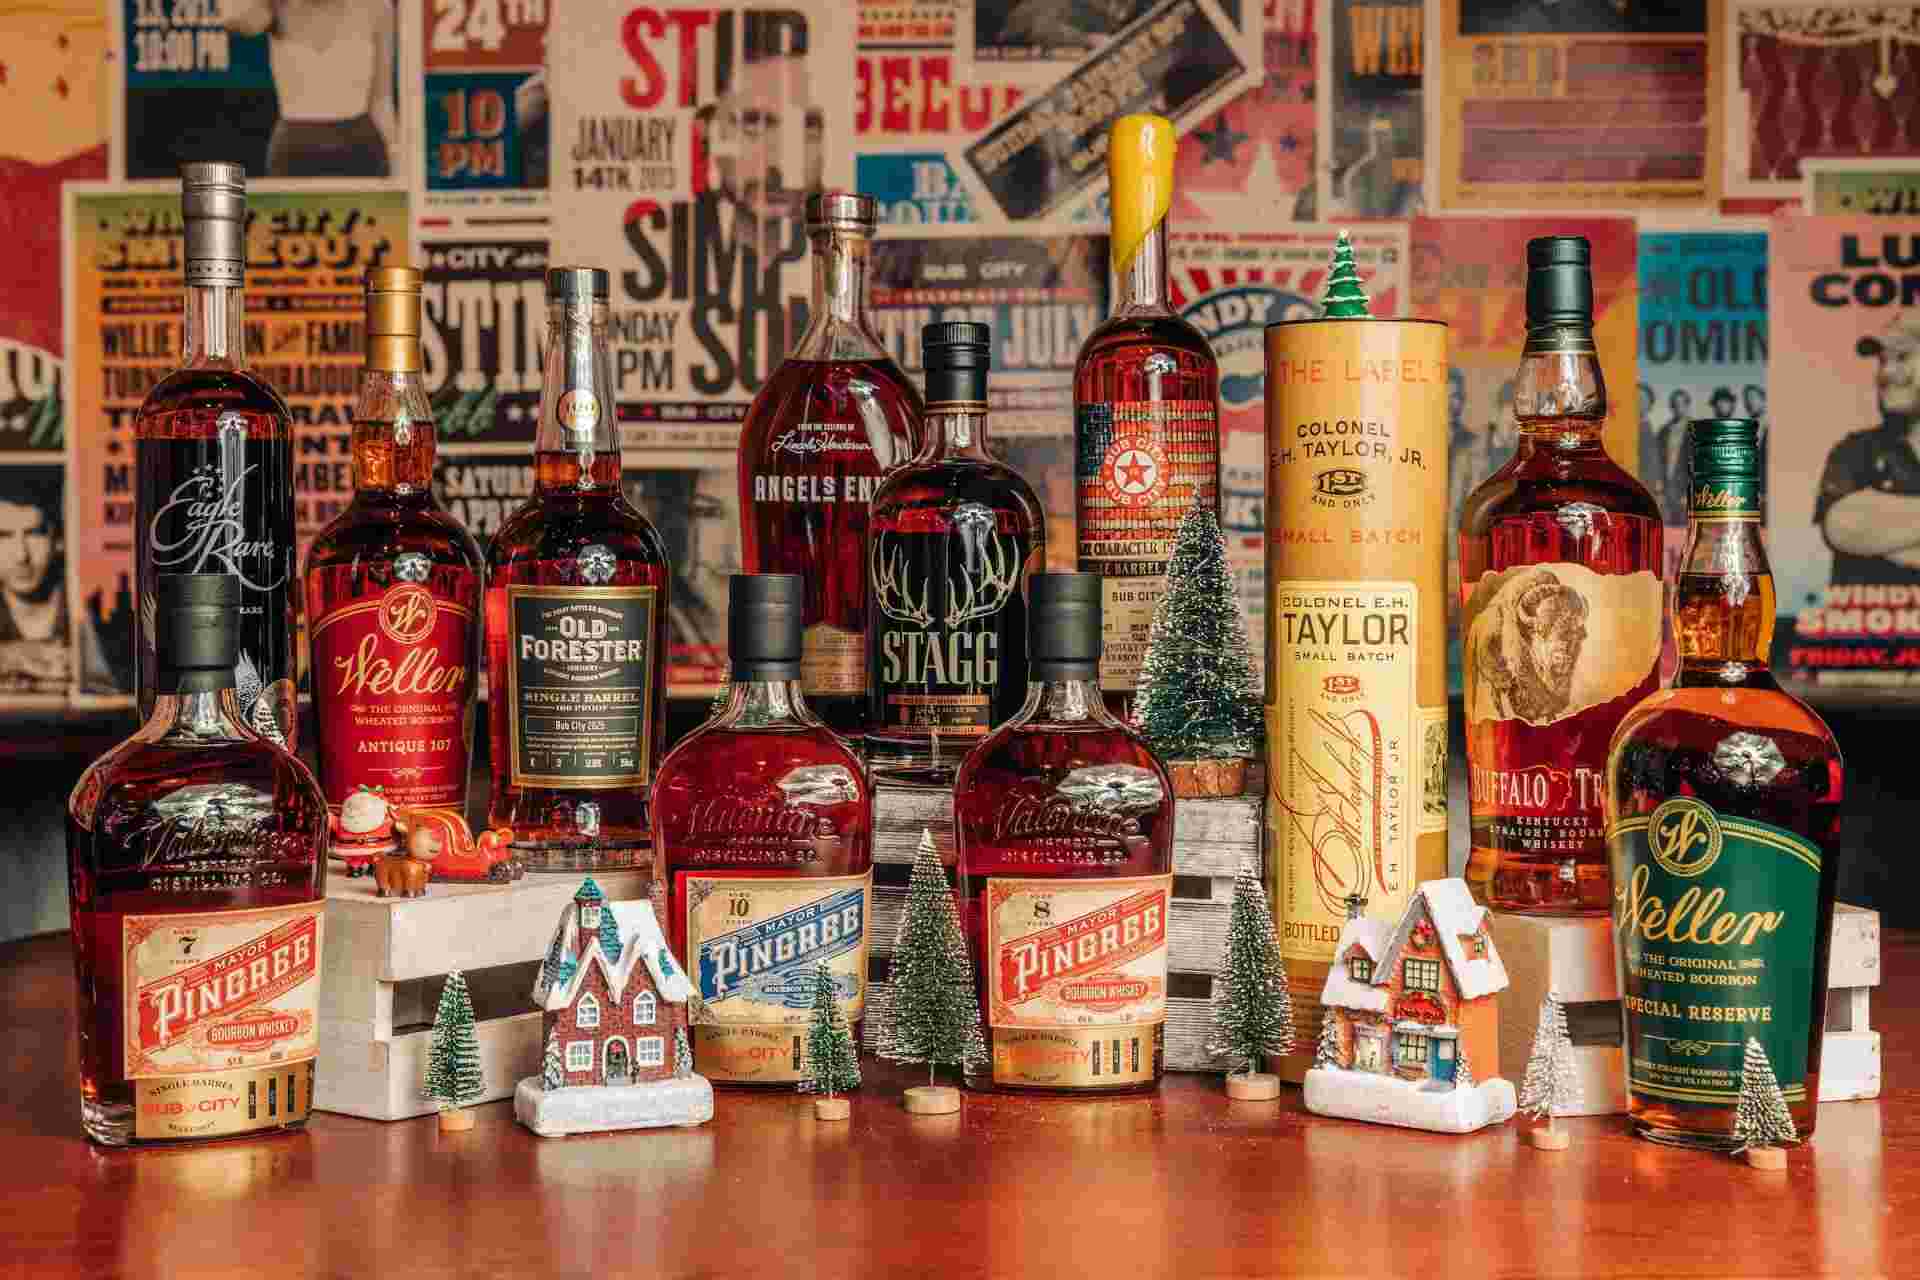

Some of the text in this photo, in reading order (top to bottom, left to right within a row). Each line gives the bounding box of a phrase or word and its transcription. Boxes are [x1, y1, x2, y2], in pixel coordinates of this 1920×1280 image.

[440, 88, 505, 140] 10
[571, 115, 676, 161] JANUARY
[440, 143, 505, 177] PM
[445, 246, 513, 269] CITY
[616, 350, 674, 391] PM
[1296, 420, 1392, 438] COLONEL
[1399, 447, 1428, 471] JR.
[1351, 528, 1422, 545] BATCH
[1282, 596, 1409, 609] COLONEL E.H.
[559, 615, 608, 640] OLD
[1283, 613, 1409, 645] TAYLOR
[520, 634, 644, 664] FORESTER
[882, 629, 998, 685] STAGG
[1294, 651, 1396, 661] SMALL BATCH
[334, 632, 465, 696] Weller
[369, 703, 392, 714] THE
[524, 692, 641, 704] SINGLE BARREL
[357, 739, 452, 755] ANTIQUE 107
[1472, 766, 1547, 807] BUFFALO
[1388, 774, 1400, 845] TAYLOR
[1516, 816, 1589, 827] KENTUCKY
[1521, 839, 1585, 850] WHISKEY
[728, 899, 750, 916] 10
[1032, 901, 1052, 918] 8
[1614, 864, 1785, 945] Weller
[765, 908, 816, 935] MAYOR
[1065, 909, 1118, 936] MAYOR
[1285, 921, 1340, 943] BOTTLED
[178, 935, 198, 955] 7
[214, 940, 268, 972] MAYOR
[708, 904, 861, 996] PINGREE
[1010, 904, 1160, 1000] PINGREE
[1643, 952, 1737, 970] THE ORIGINAL
[151, 932, 312, 1047] PINGREE
[1689, 973, 1758, 986] BOURBON
[1688, 1005, 1773, 1023] RESERVE
[211, 1020, 297, 1042] BOURBON WHISKEY
[197, 1097, 241, 1113] CITY
